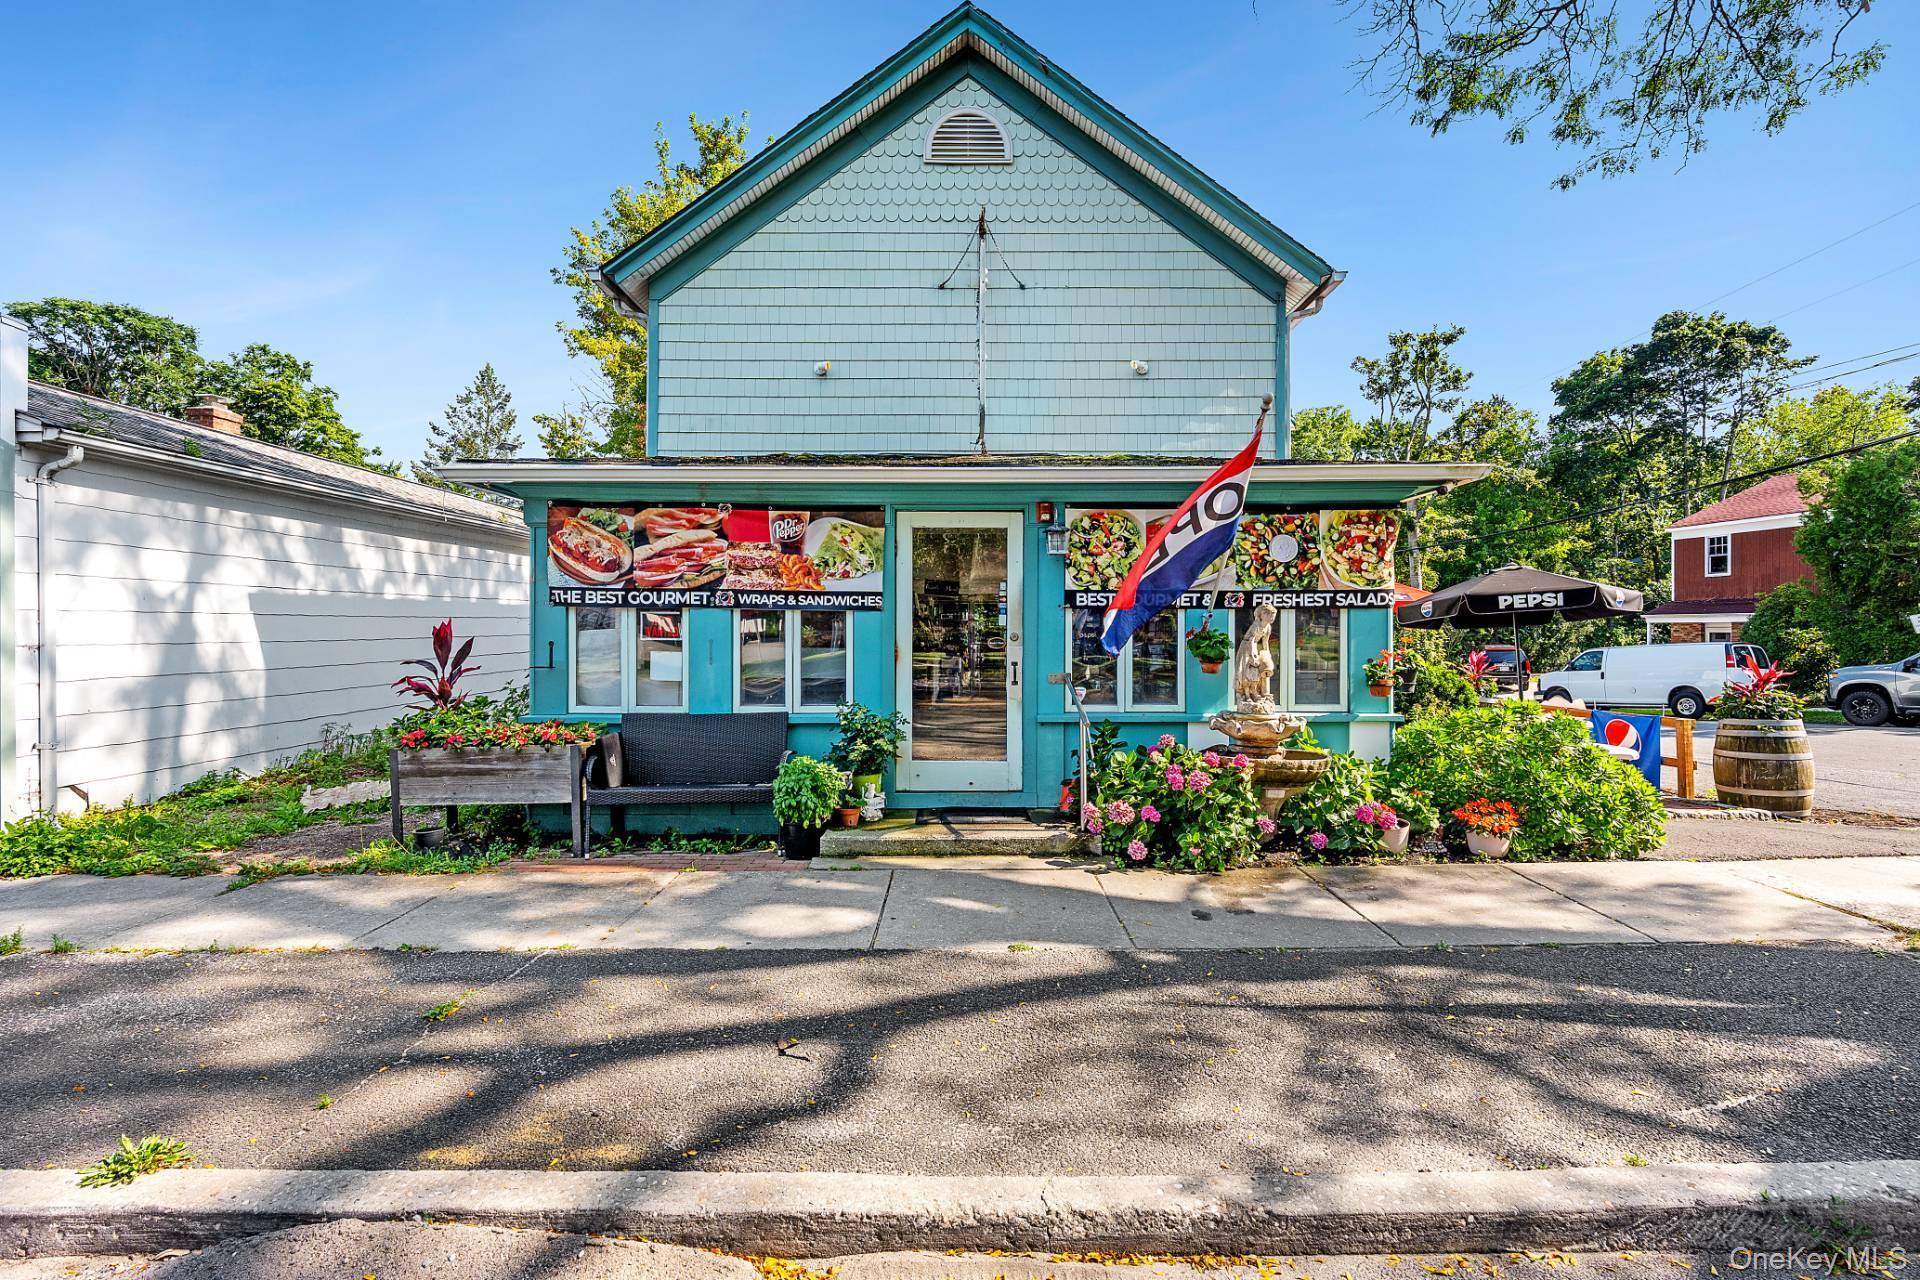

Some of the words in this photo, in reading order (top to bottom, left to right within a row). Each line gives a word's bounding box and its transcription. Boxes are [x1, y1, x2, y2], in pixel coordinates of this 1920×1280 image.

[775, 521, 804, 539] Pepper
[784, 518, 797, 531] Dr
[553, 590, 582, 604] THE
[585, 590, 625, 605] BEST
[628, 591, 711, 606] GOURMET
[738, 593, 785, 607] WRAPS
[787, 594, 796, 606] &
[798, 594, 883, 607] SANDWICHES
[1076, 593, 1116, 606] BEST
[1202, 593, 1211, 606] &
[1252, 593, 1332, 607] FRESHEST
[1336, 593, 1394, 607] SALADS
[1498, 592, 1564, 609] PEPSI
